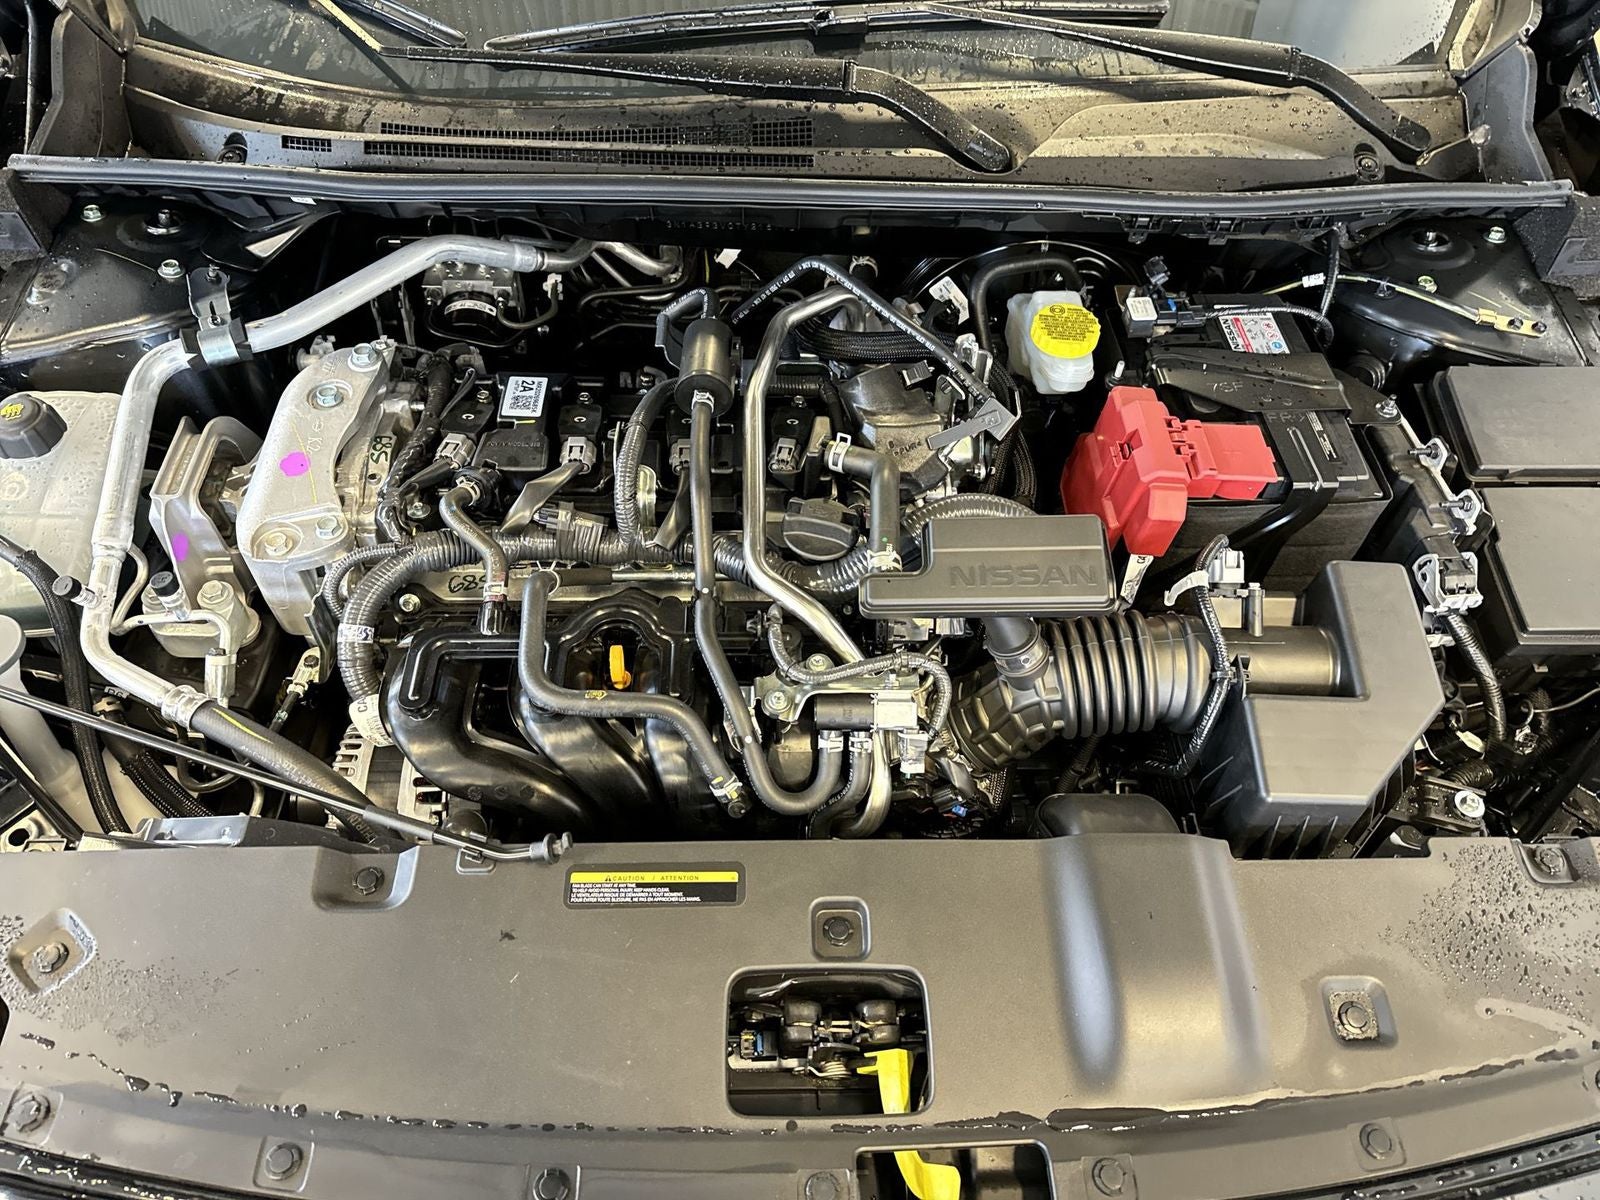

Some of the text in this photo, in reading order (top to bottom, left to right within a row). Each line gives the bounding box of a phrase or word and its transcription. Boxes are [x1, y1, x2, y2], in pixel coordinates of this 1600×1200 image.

[1222, 318, 1240, 350] NISSAN
[520, 380, 536, 392] 2A
[950, 563, 1097, 588] NISSAN
